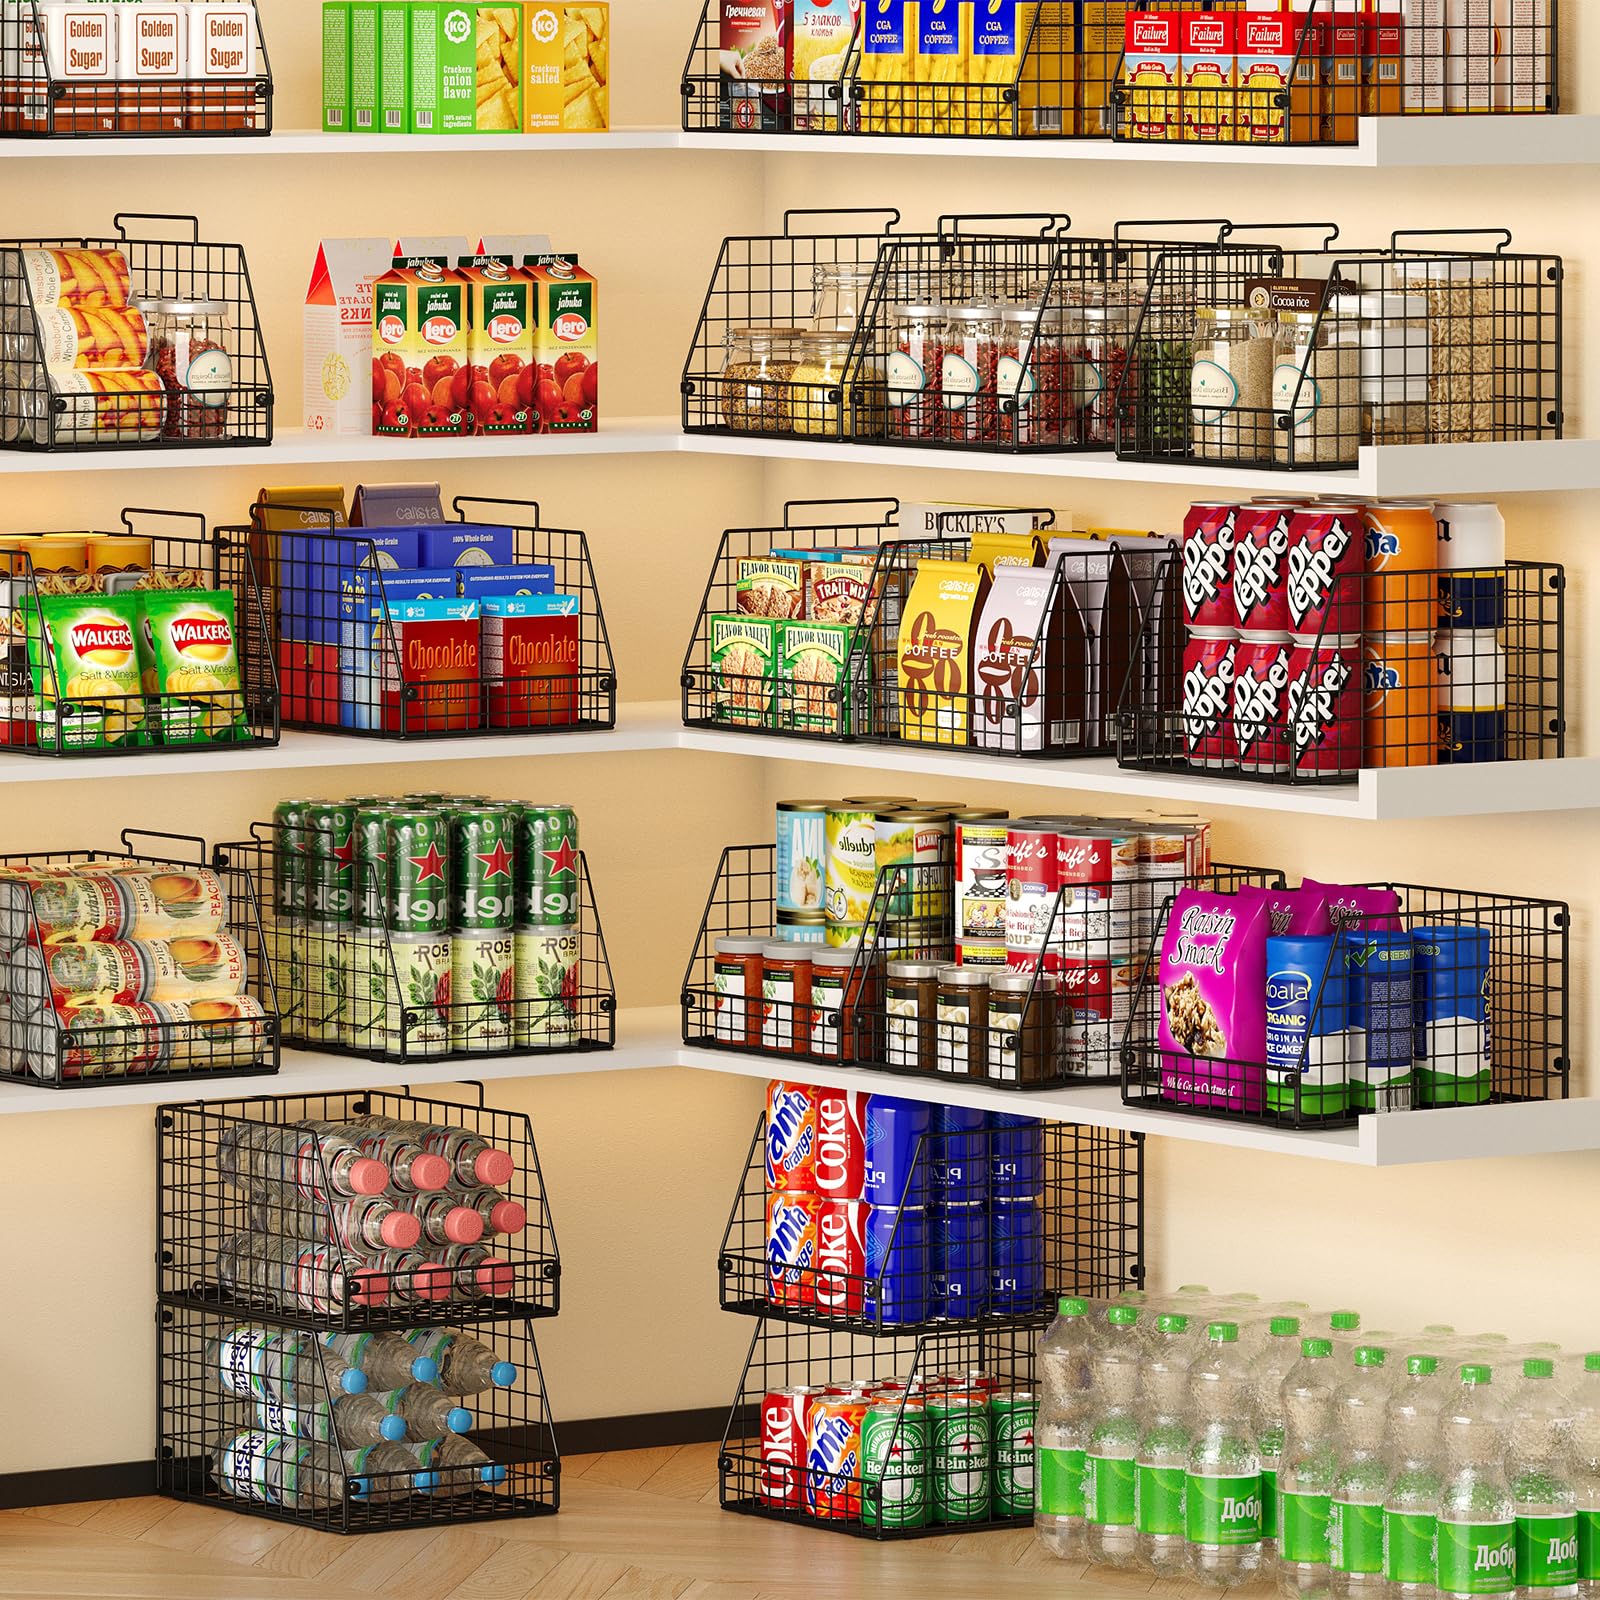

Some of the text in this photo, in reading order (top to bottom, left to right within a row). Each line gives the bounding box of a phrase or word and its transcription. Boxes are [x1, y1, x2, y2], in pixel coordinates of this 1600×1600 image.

[725, 4, 766, 18] Гречневая
[449, 22, 467, 32] KO
[536, 21, 554, 32] KO
[803, 12, 842, 27] 5 злаков
[876, 20, 891, 30] CGA
[931, 21, 946, 31] CGA
[986, 22, 1002, 31] CGA
[70, 20, 102, 38] Golden
[141, 20, 173, 37] Golden
[211, 20, 243, 37] Golden
[1136, 26, 1168, 40] Failure
[1192, 26, 1222, 41] Failure
[1249, 26, 1281, 42] Failure
[870, 34, 898, 44] COFFEE
[924, 35, 953, 45] COFFEE
[979, 35, 1009, 45] COFFEE
[70, 48, 102, 70] Sugar
[141, 48, 173, 69] Sugar
[210, 48, 243, 69] Sugar
[443, 65, 472, 74] Crackers
[531, 65, 560, 73] Crackers
[443, 75, 472, 86] onion
[531, 73, 560, 84] salted
[443, 88, 472, 99] flavor
[44, 277, 56, 304] Whole
[425, 300, 452, 314] jabuka
[491, 299, 518, 312] jabuka
[557, 298, 583, 311] jabuka
[1272, 294, 1310, 307] Cocoa rice
[425, 321, 453, 340] Lero
[492, 319, 521, 338] Lero
[557, 317, 586, 336] Lero
[62, 334, 73, 363] Whole
[465, 534, 479, 543] Whole
[480, 534, 494, 543] Grain
[741, 562, 799, 585] FLAVOR VALLEY
[816, 581, 849, 599] TRAIL
[71, 627, 133, 648] WALKERS
[171, 622, 231, 642] WALKERS
[716, 623, 770, 650] FLAVOR VALLEY
[509, 634, 576, 666] Chocolate
[787, 628, 843, 656] FLAVOR VALLEY
[409, 638, 477, 670] Chocolate
[904, 644, 959, 659] COFFEE
[981, 651, 1035, 666] COFFE
[80, 671, 102, 682] Salt
[180, 665, 202, 676] Salt
[1006, 838, 1049, 864] wift's
[1057, 840, 1101, 869] wift's
[1075, 890, 1097, 898] COOING
[99, 879, 118, 926] APPLES
[1017, 922, 1035, 931] Rice
[1182, 905, 1237, 936] Raisin
[1168, 936, 1230, 975] Smack
[118, 943, 137, 991] APPLES
[1076, 1010, 1097, 1019] COOING
[1276, 1044, 1304, 1055] CAKES
[783, 1124, 814, 1172] orange
[815, 1098, 847, 1191] Coke
[816, 1213, 848, 1306] Coke
[761, 1406, 793, 1498] Coke
[866, 1460, 925, 1476] Heneken
